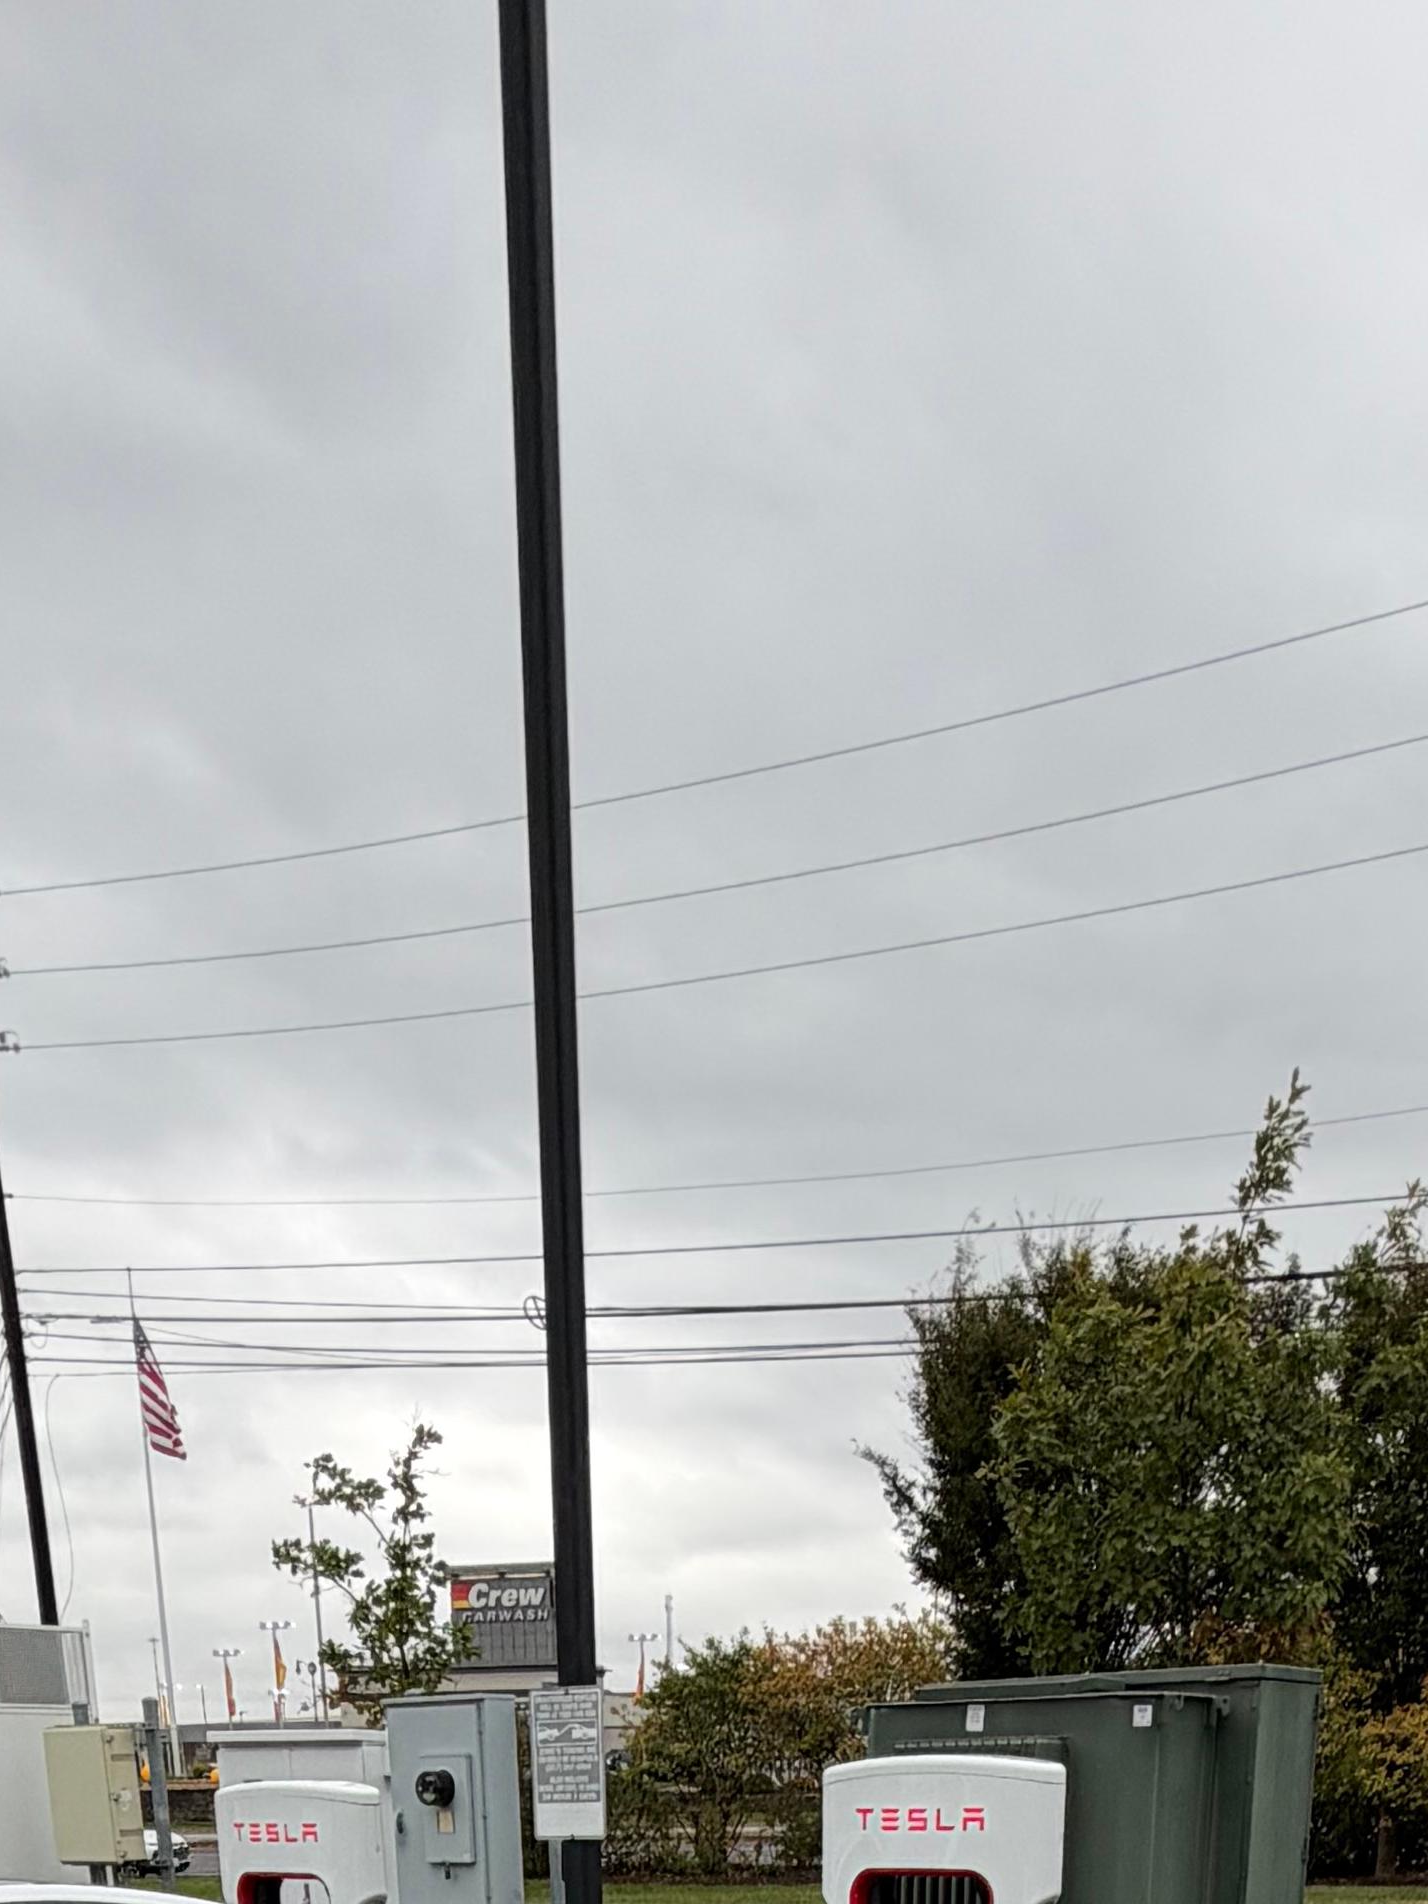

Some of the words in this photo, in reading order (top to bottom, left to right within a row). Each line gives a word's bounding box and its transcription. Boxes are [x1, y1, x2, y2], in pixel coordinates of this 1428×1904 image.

[468, 1582, 545, 1608] Crew
[462, 1608, 549, 1623] CARWASH
[855, 1808, 985, 1831] TESLA
[233, 1823, 318, 1843] TESLA
